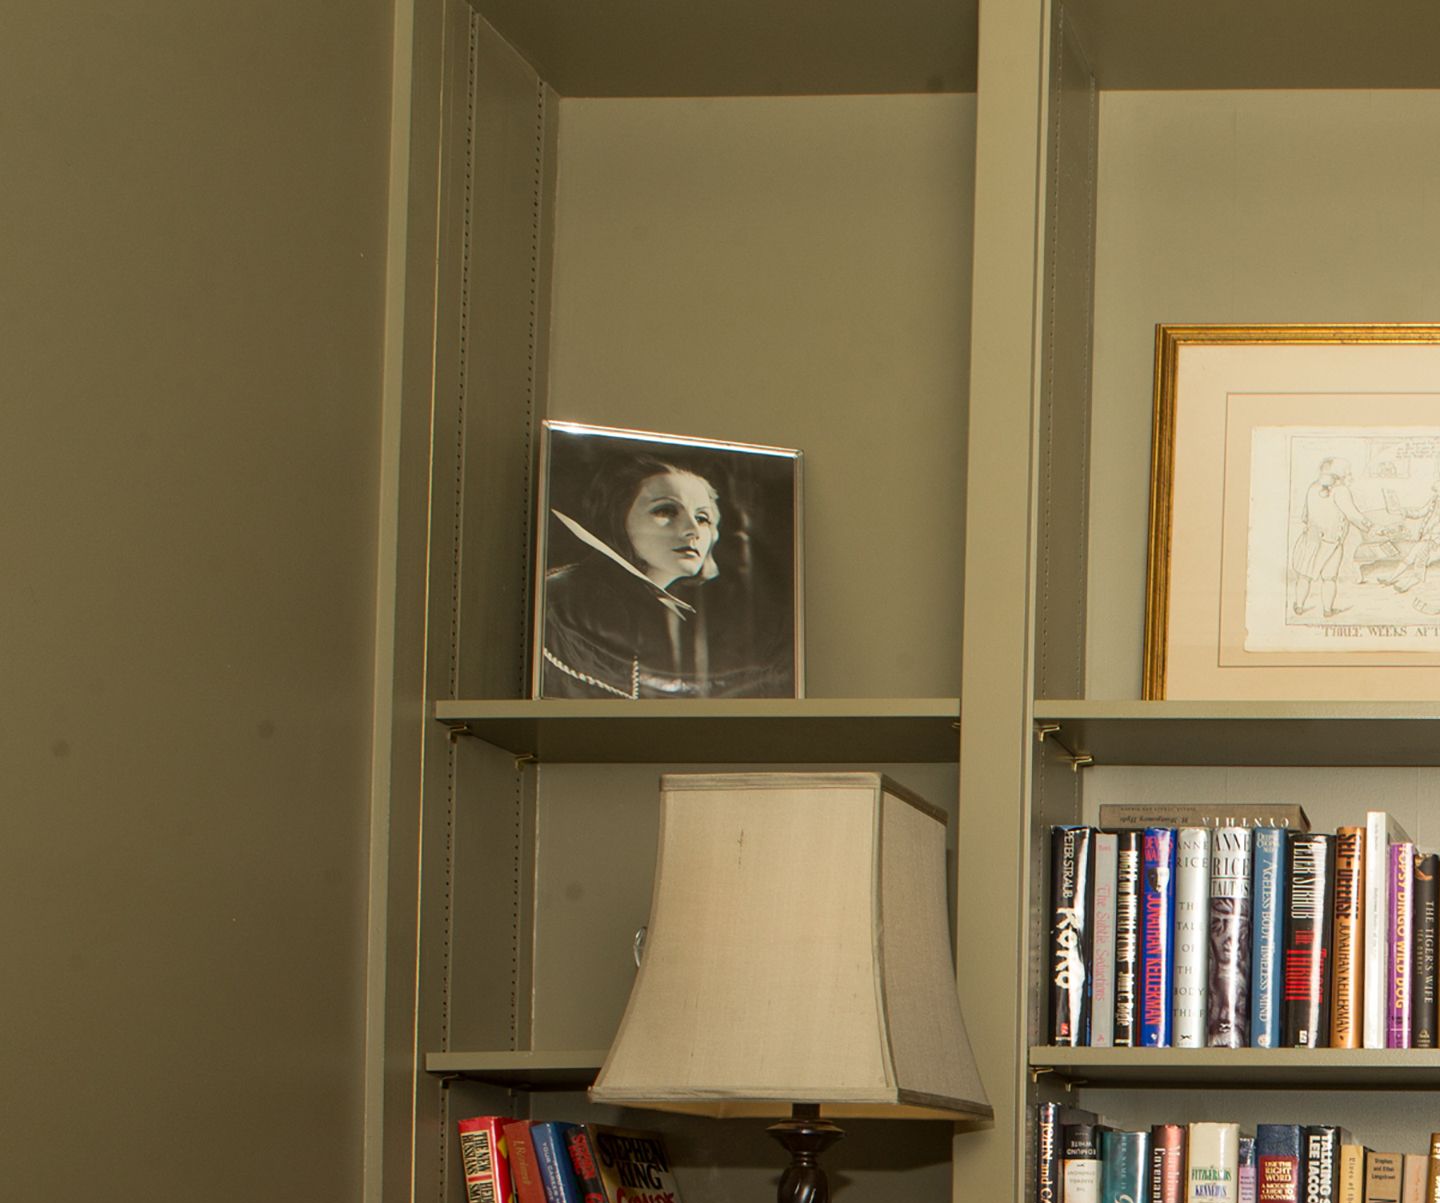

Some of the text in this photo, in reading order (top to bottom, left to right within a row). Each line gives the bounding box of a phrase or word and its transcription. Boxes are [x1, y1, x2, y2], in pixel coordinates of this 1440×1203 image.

[1322, 625, 1362, 638] THREE
[1369, 625, 1407, 638] WEEKS
[1215, 833, 1250, 852] ANNE
[1213, 857, 1249, 876] RICE
[1424, 901, 1434, 1004] THE TIGER'S WIFE
[1337, 923, 1352, 1033] JONATHAN KELLERMAN
[462, 1134, 478, 1176] RUSSIANS
[596, 1132, 669, 1173] STEPHEN
[1309, 1135, 1320, 1159] LEE
[1319, 1134, 1333, 1196] TALKING
[542, 1142, 552, 1164] YOUR
[547, 1166, 558, 1196] CAREER
[614, 1159, 664, 1190] KING
